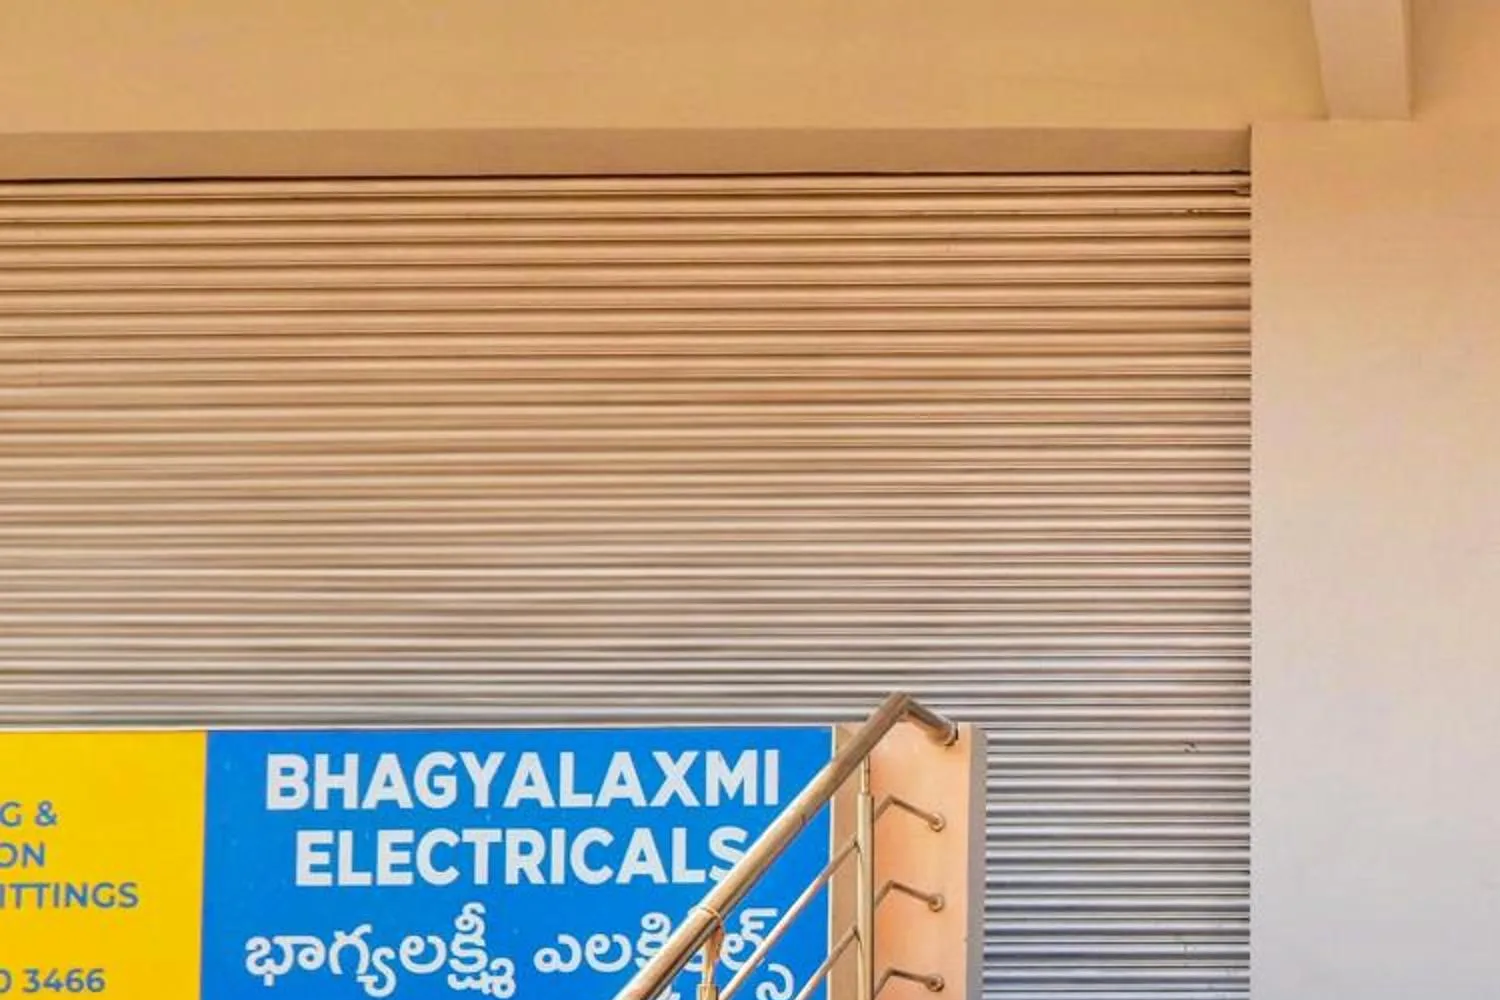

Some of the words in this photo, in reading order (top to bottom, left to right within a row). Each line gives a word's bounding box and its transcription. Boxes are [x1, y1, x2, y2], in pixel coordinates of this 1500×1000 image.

[265, 749, 779, 811] BHAGYALAXMI
[35, 801, 57, 826] &
[295, 826, 748, 887] ELECTRICALS
[22, 968, 106, 993] 3466
